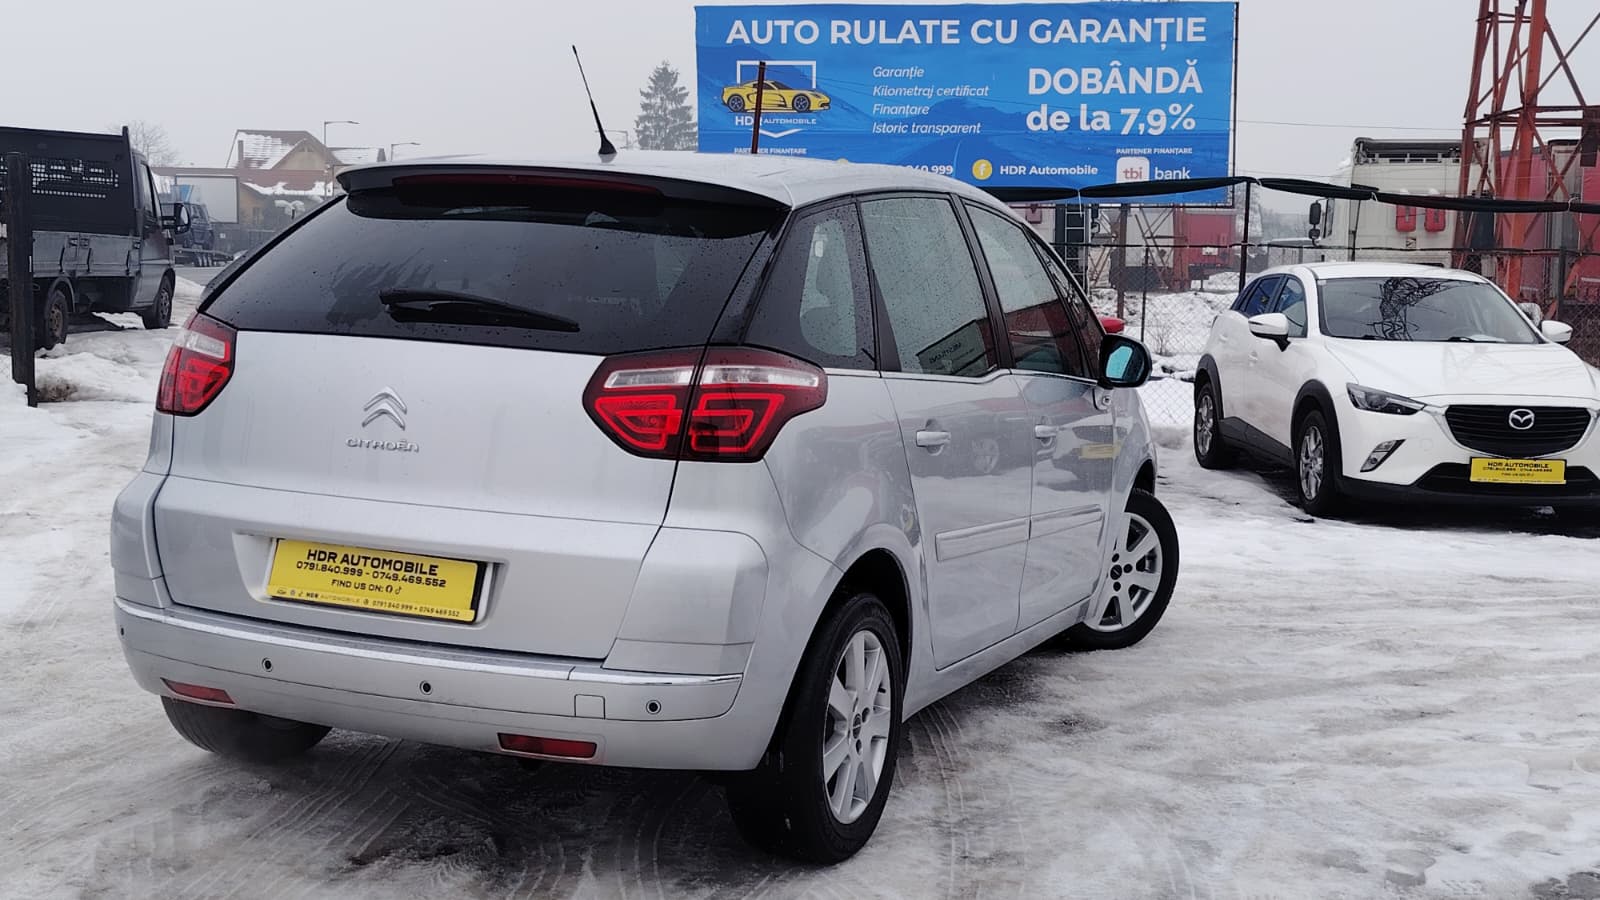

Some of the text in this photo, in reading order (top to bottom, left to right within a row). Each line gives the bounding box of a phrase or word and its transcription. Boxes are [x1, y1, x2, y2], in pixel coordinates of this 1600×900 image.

[726, 16, 1207, 51] AUTO RULATE CU GARANȚIE
[1028, 58, 1204, 96] DOBÂNDĂ
[872, 84, 990, 99] Kilometraj certificat
[1025, 103, 1197, 136] de la 7,9%
[872, 121, 982, 136] Istoric transparent
[1000, 164, 1098, 175] HDR Automobile
[1123, 166, 1191, 180] tbi bank
[306, 549, 439, 577] HDR AUTOMOBILE
[331, 579, 352, 588] FIND
[353, 582, 366, 591] US
[371, 570, 447, 588] 0749.469.552
